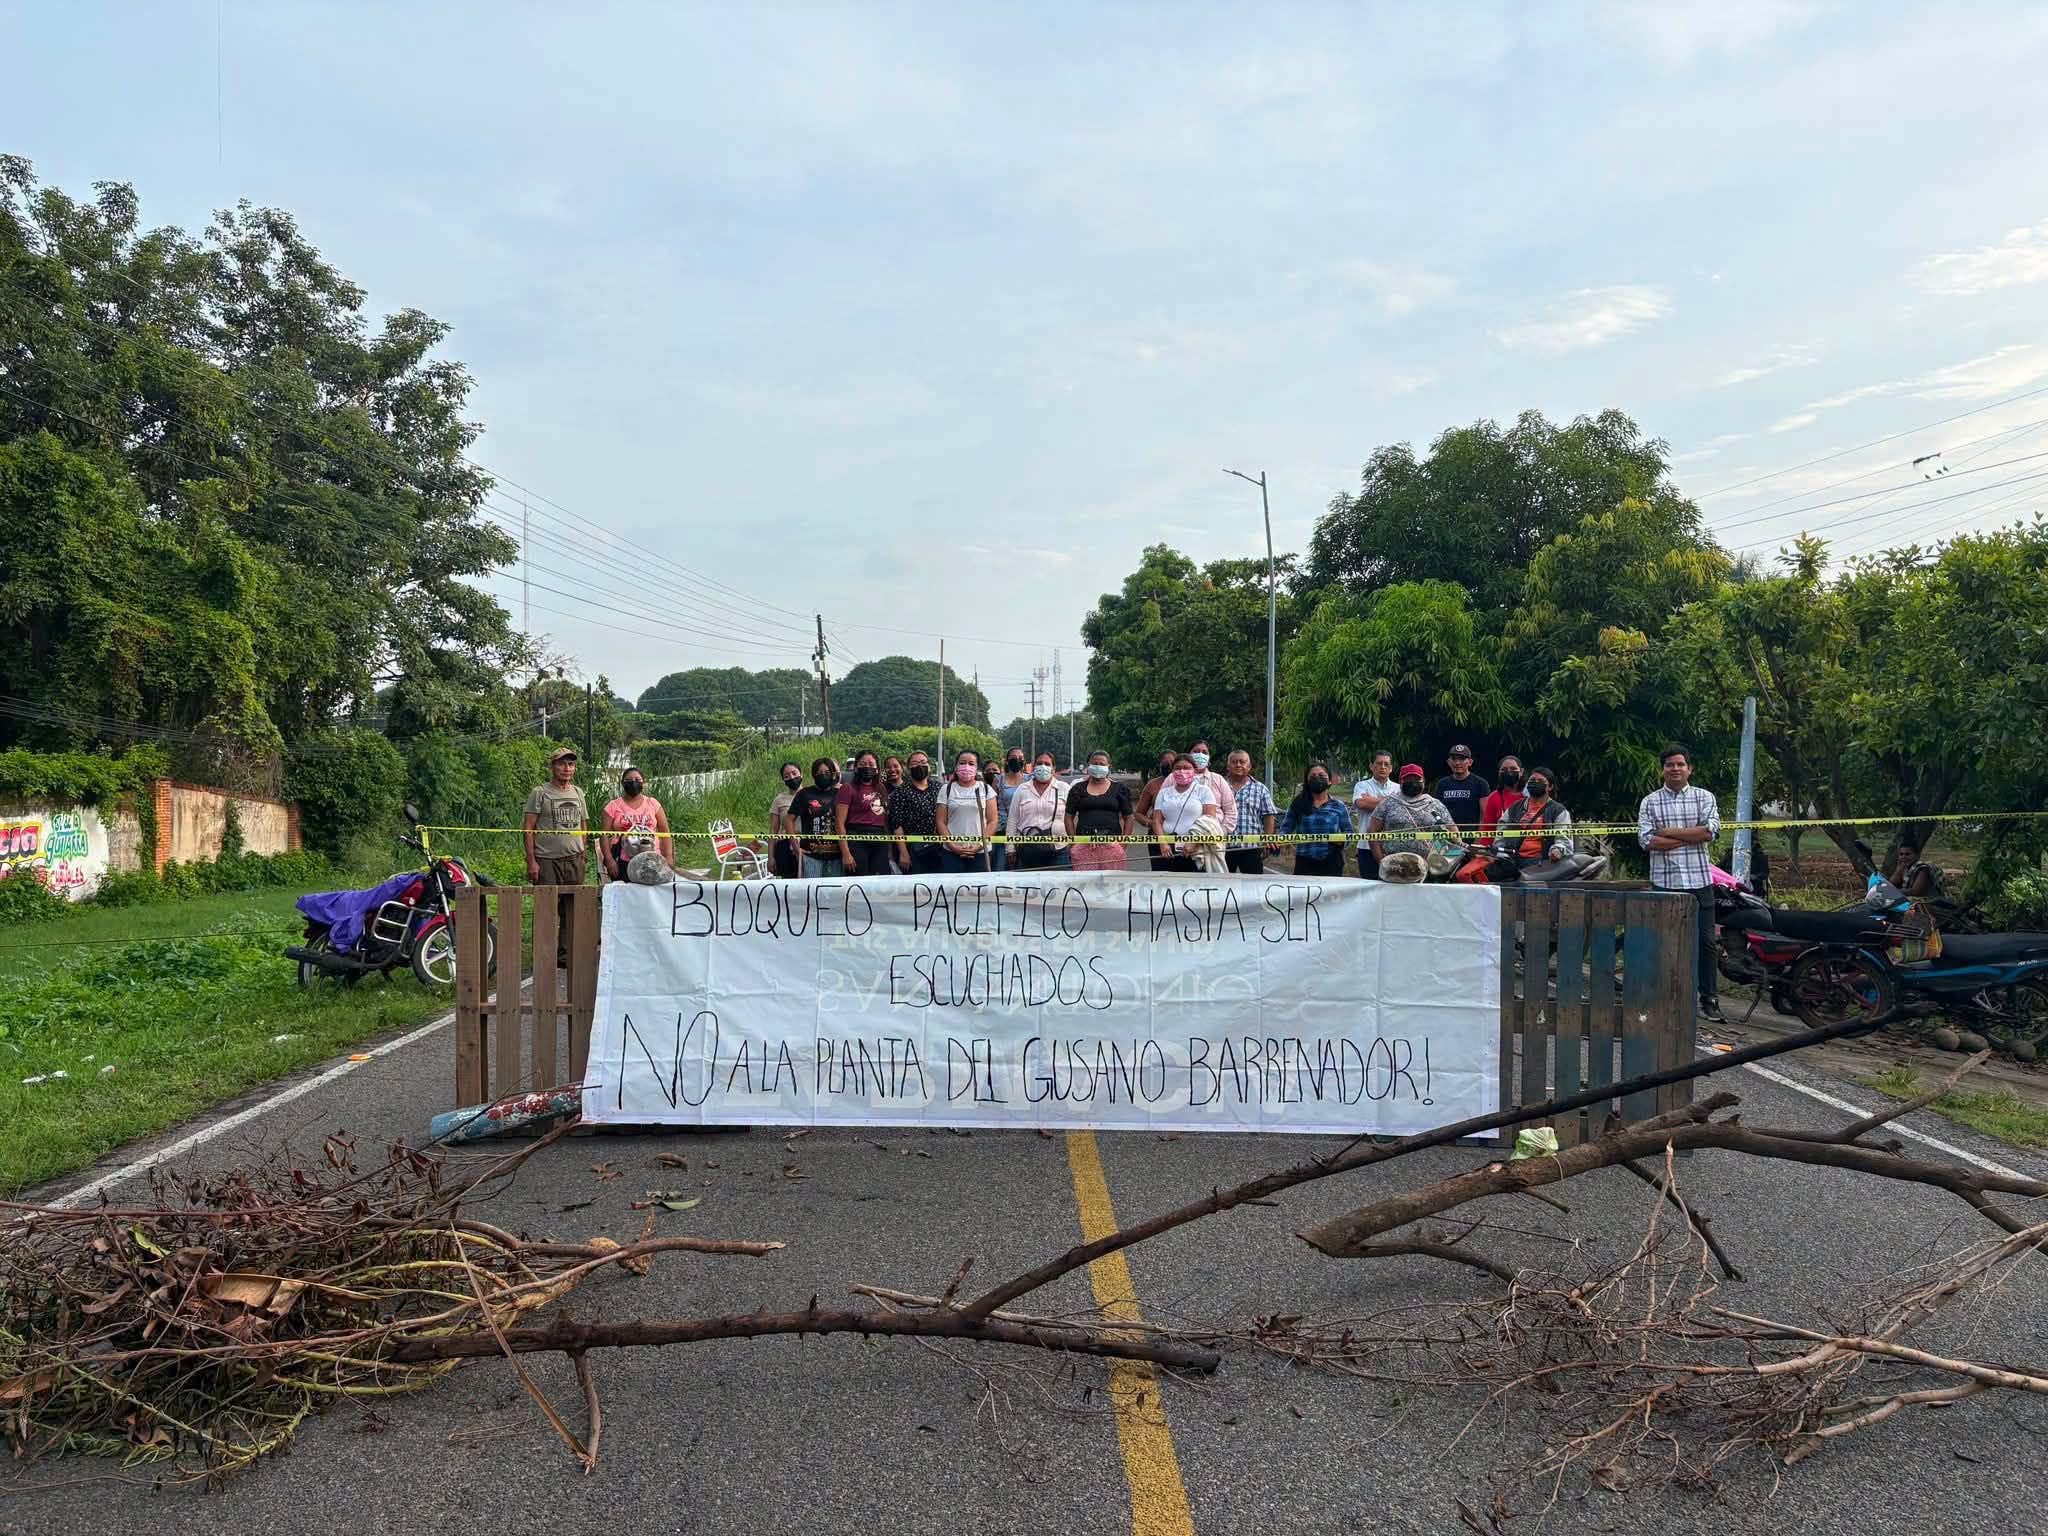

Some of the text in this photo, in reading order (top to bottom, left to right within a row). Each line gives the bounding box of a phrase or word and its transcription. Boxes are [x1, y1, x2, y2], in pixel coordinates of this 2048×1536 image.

[671, 882, 874, 939] BLOQUEO
[913, 884, 1090, 940] PACIFICO
[1127, 887, 1246, 943] HASTA
[1260, 885, 1322, 943] SER
[889, 953, 1113, 1010] ESCUCHADOS
[618, 1010, 1434, 1110] NO A LA PLANTA DEL GUSANO BARRENADOR!
